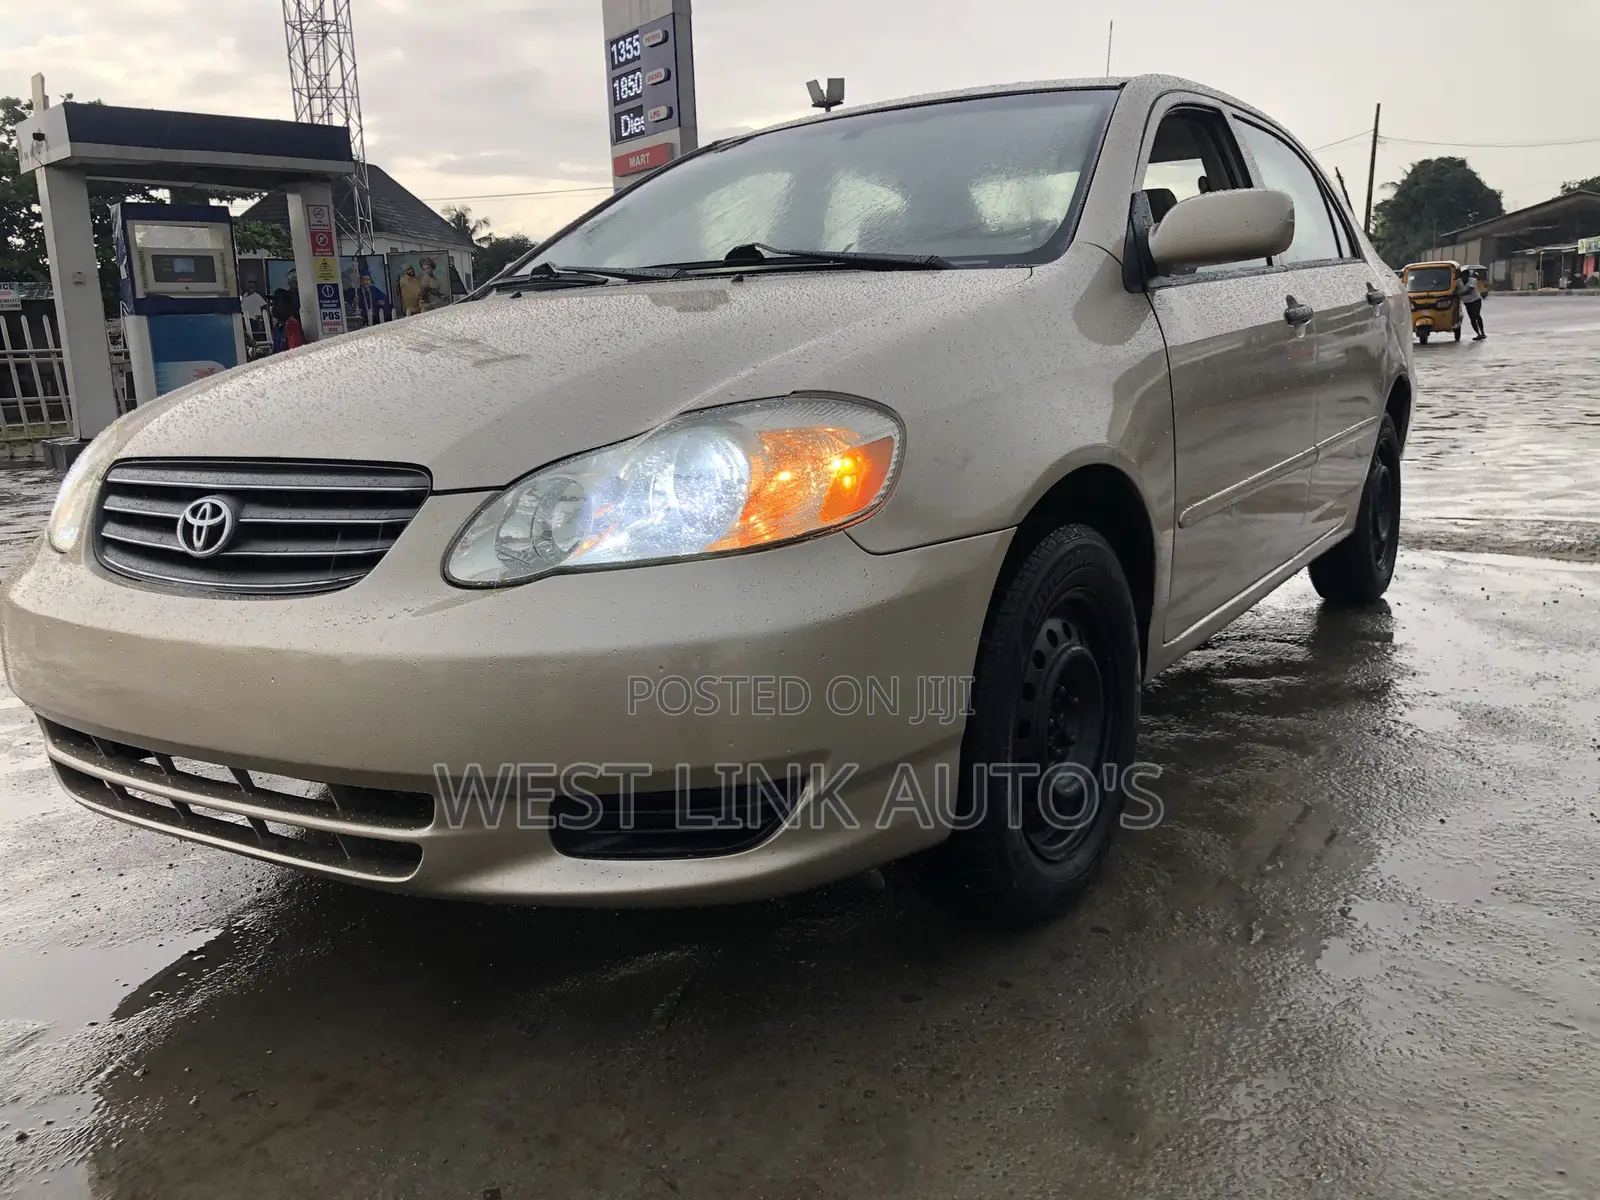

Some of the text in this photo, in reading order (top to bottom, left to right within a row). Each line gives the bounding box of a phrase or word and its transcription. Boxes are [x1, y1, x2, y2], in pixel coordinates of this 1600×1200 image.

[611, 34, 641, 65] 1355
[647, 71, 663, 82] DIESEL
[613, 71, 643, 101] 1850
[650, 110, 661, 120] LPG
[629, 152, 651, 168] MART
[322, 311, 340, 320] POS
